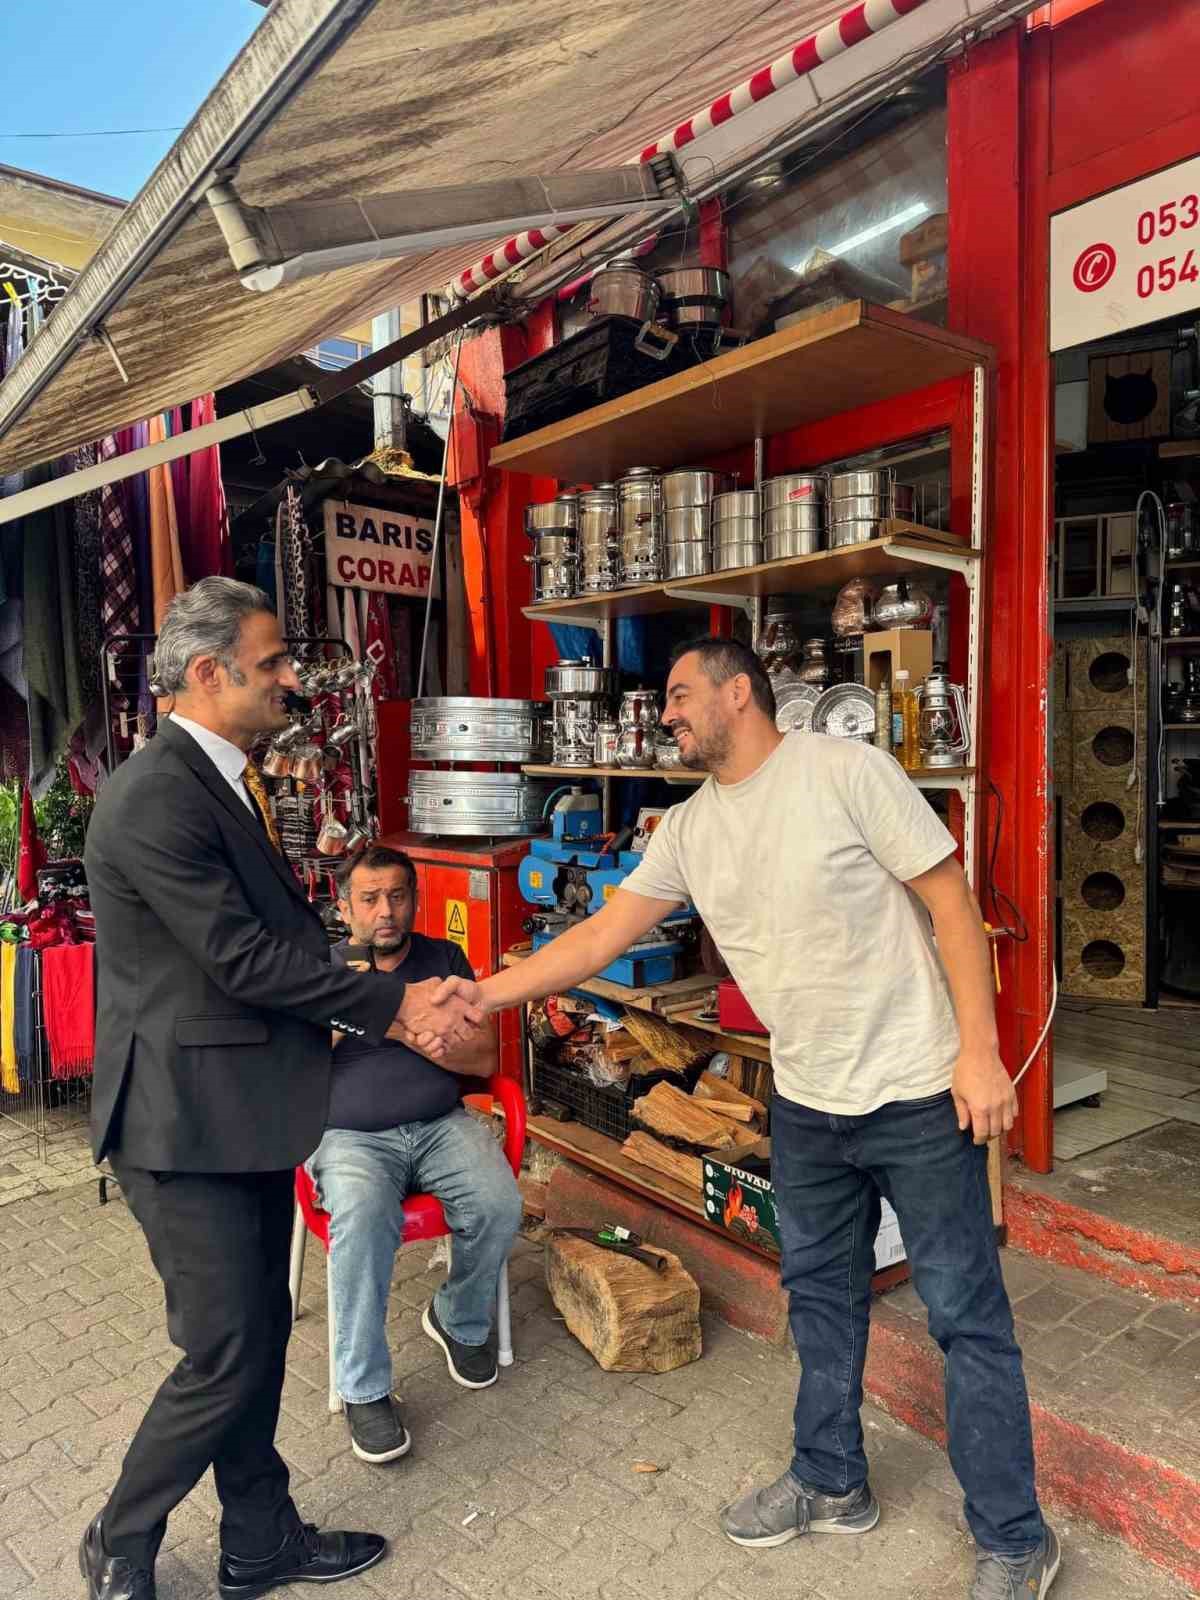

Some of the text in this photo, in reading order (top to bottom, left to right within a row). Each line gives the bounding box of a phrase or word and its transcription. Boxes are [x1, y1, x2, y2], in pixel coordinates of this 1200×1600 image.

[1137, 194, 1199, 245] 053
[1136, 249, 1199, 298] 054
[335, 512, 433, 555] BARIŞ
[336, 554, 431, 588] ÇORAP
